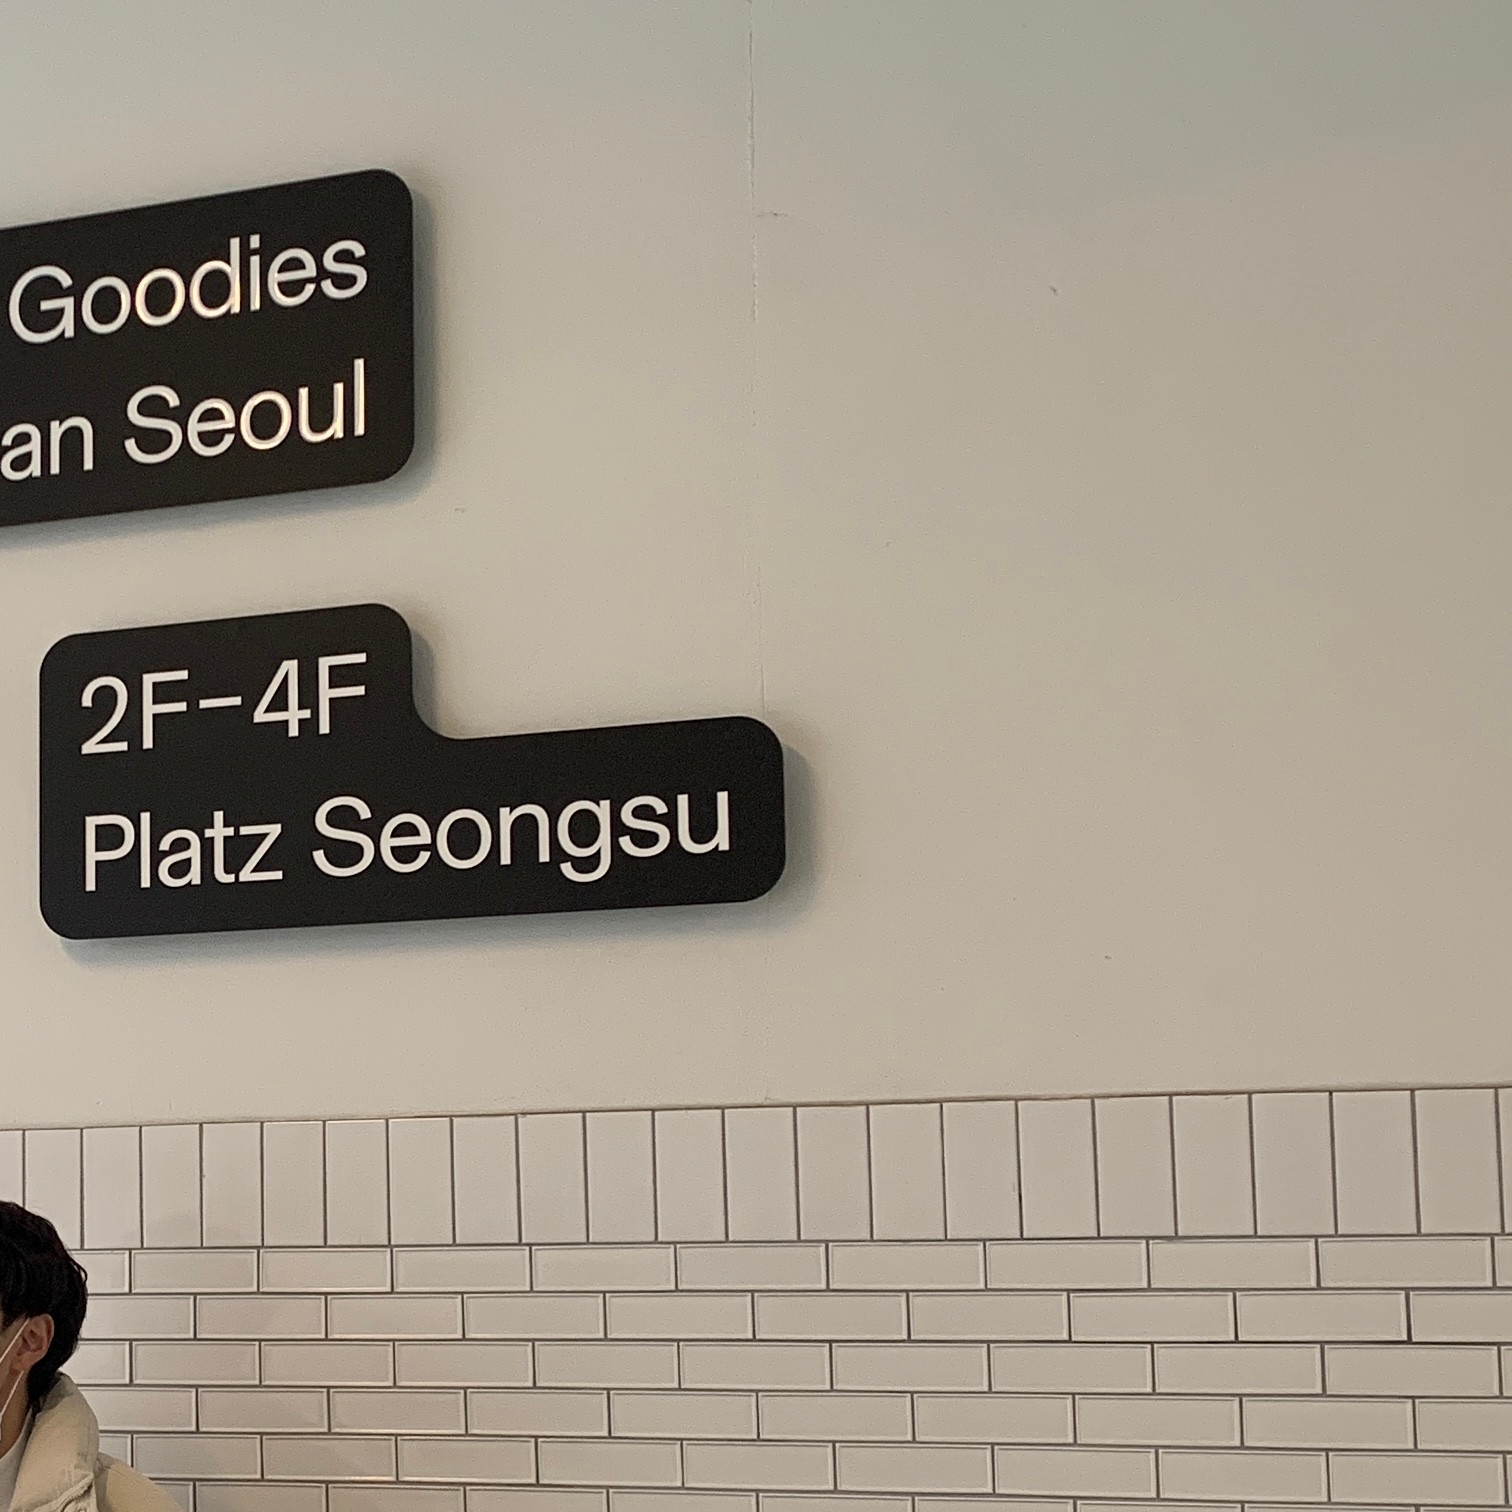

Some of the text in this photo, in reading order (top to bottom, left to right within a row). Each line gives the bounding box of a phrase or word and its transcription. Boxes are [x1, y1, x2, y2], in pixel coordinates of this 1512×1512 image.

[7, 233, 369, 345] Goodies
[123, 356, 366, 465] Seoul
[84, 789, 731, 893] Platz Seongsu
